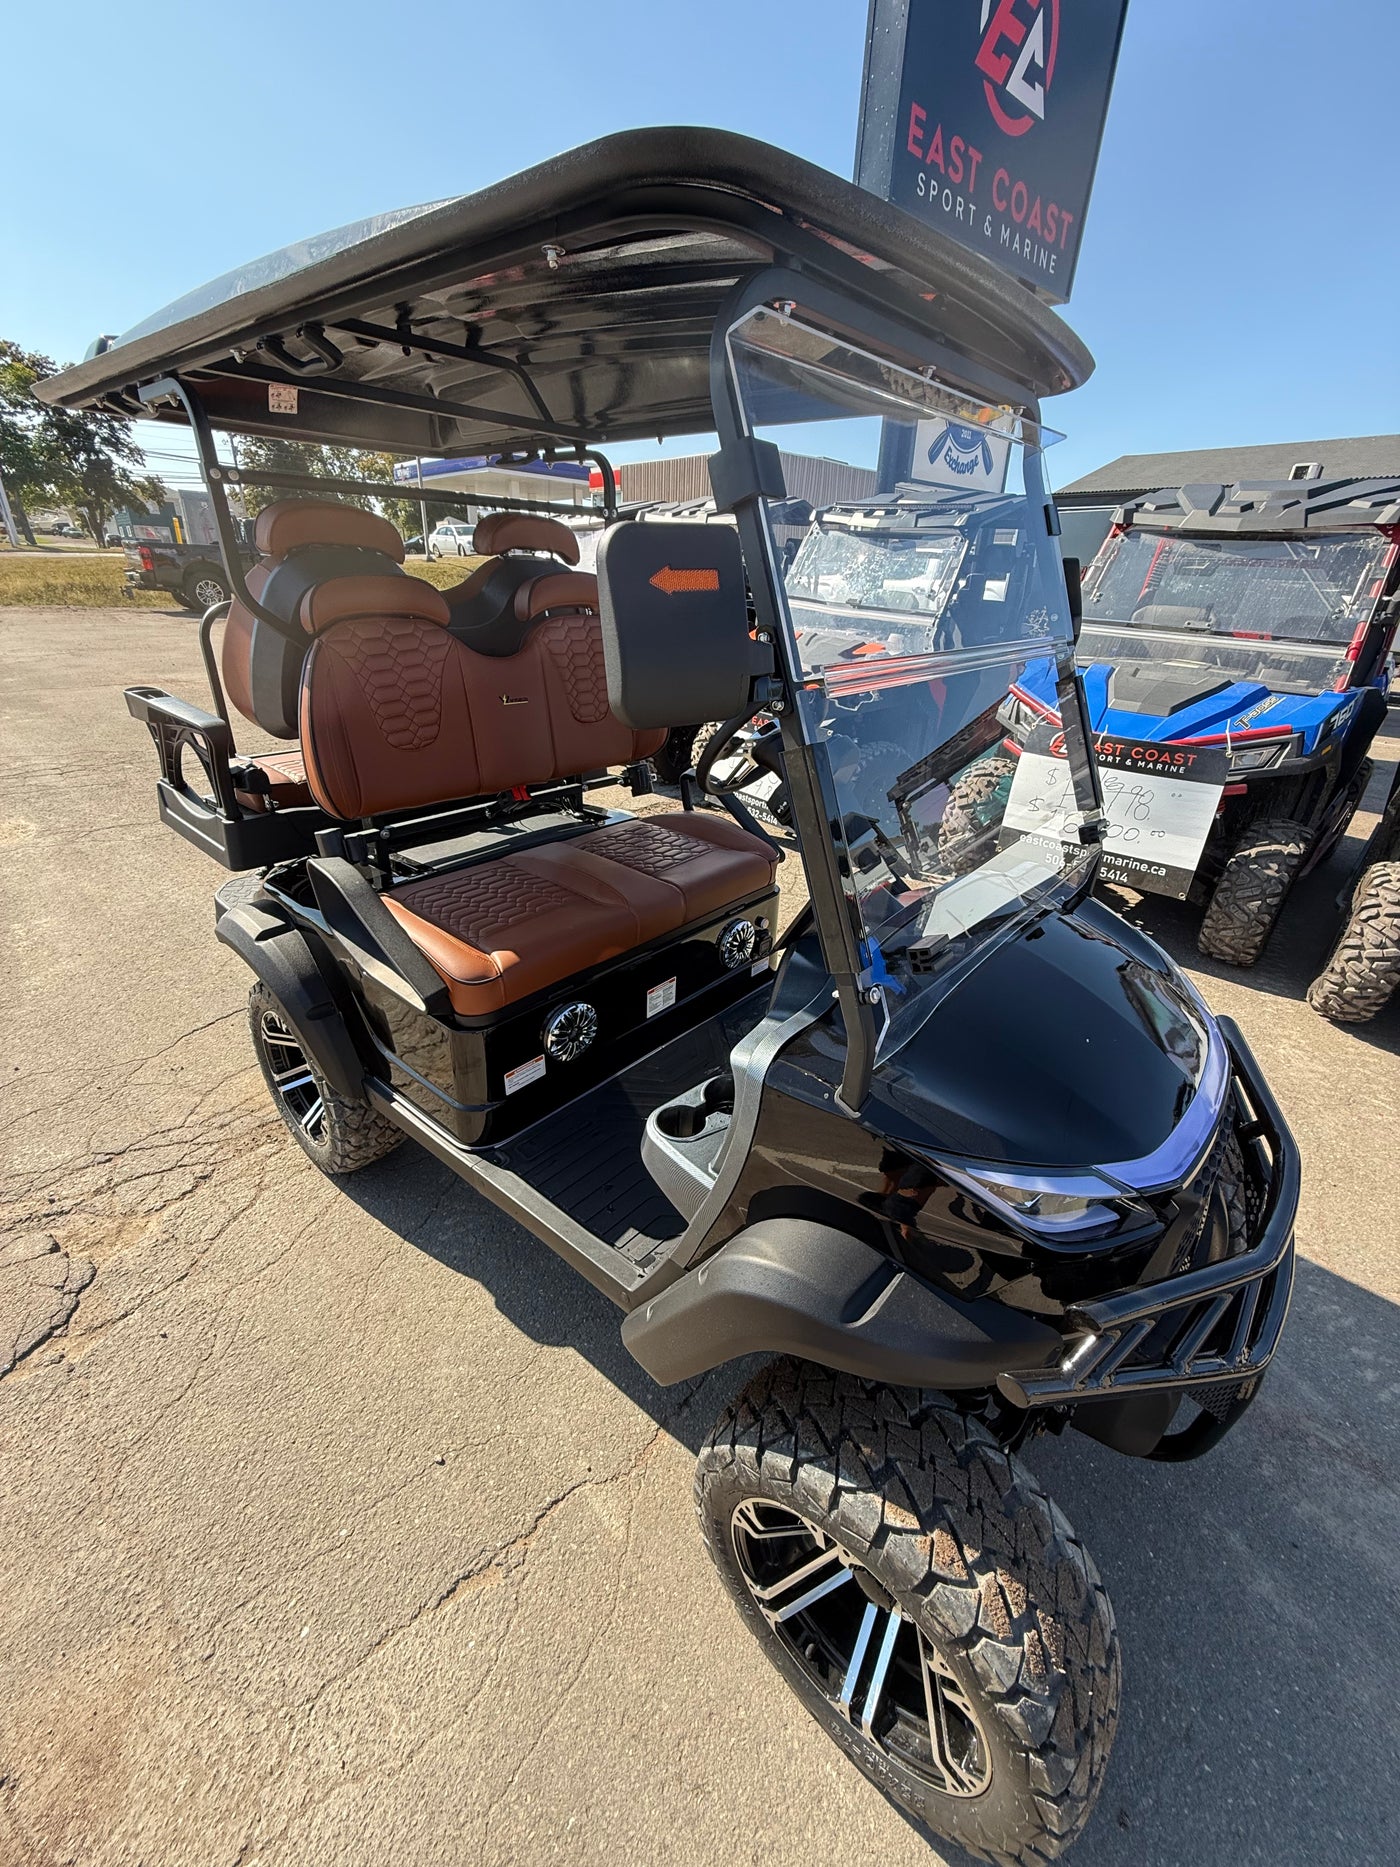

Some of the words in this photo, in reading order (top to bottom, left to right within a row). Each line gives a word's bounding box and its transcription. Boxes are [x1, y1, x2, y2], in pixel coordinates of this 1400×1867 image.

[907, 101, 983, 193] EAST
[992, 168, 1073, 249] COAST
[916, 172, 976, 226] SPORT
[984, 214, 992, 238] &
[1000, 223, 1056, 274] MARINE
[944, 446, 979, 475] Exchange
[1094, 742, 1125, 756] AST
[1131, 747, 1198, 767] COAST
[1095, 753, 1121, 764] ORT
[1125, 758, 1132, 766] &
[1137, 760, 1186, 774] MARINE
